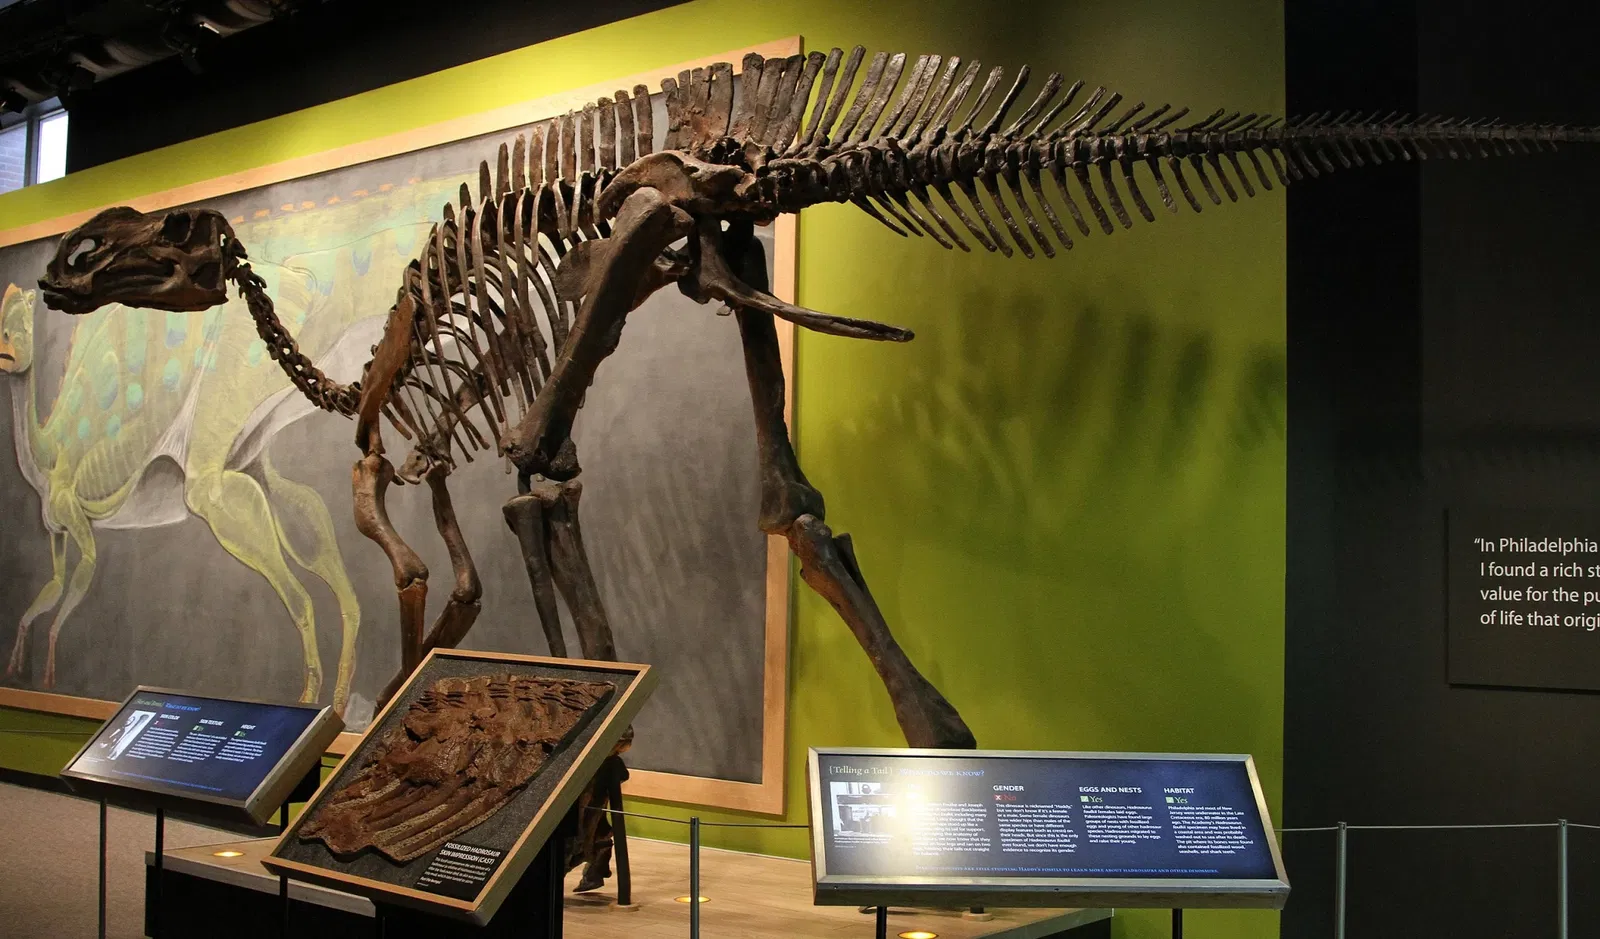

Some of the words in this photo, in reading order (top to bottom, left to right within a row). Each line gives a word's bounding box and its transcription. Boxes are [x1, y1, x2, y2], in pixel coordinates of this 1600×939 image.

[1474, 538, 1495, 552] “In
[1500, 538, 1598, 556] Philadelphia
[1480, 562, 1484, 576] I
[1488, 562, 1535, 577] found
[1539, 566, 1548, 577] a
[1553, 562, 1583, 577] rich
[1480, 586, 1522, 601] value
[1526, 586, 1548, 602] for
[1552, 587, 1579, 602] the
[1480, 610, 1497, 624] of
[1500, 610, 1523, 625] life
[1527, 611, 1560, 626] that
